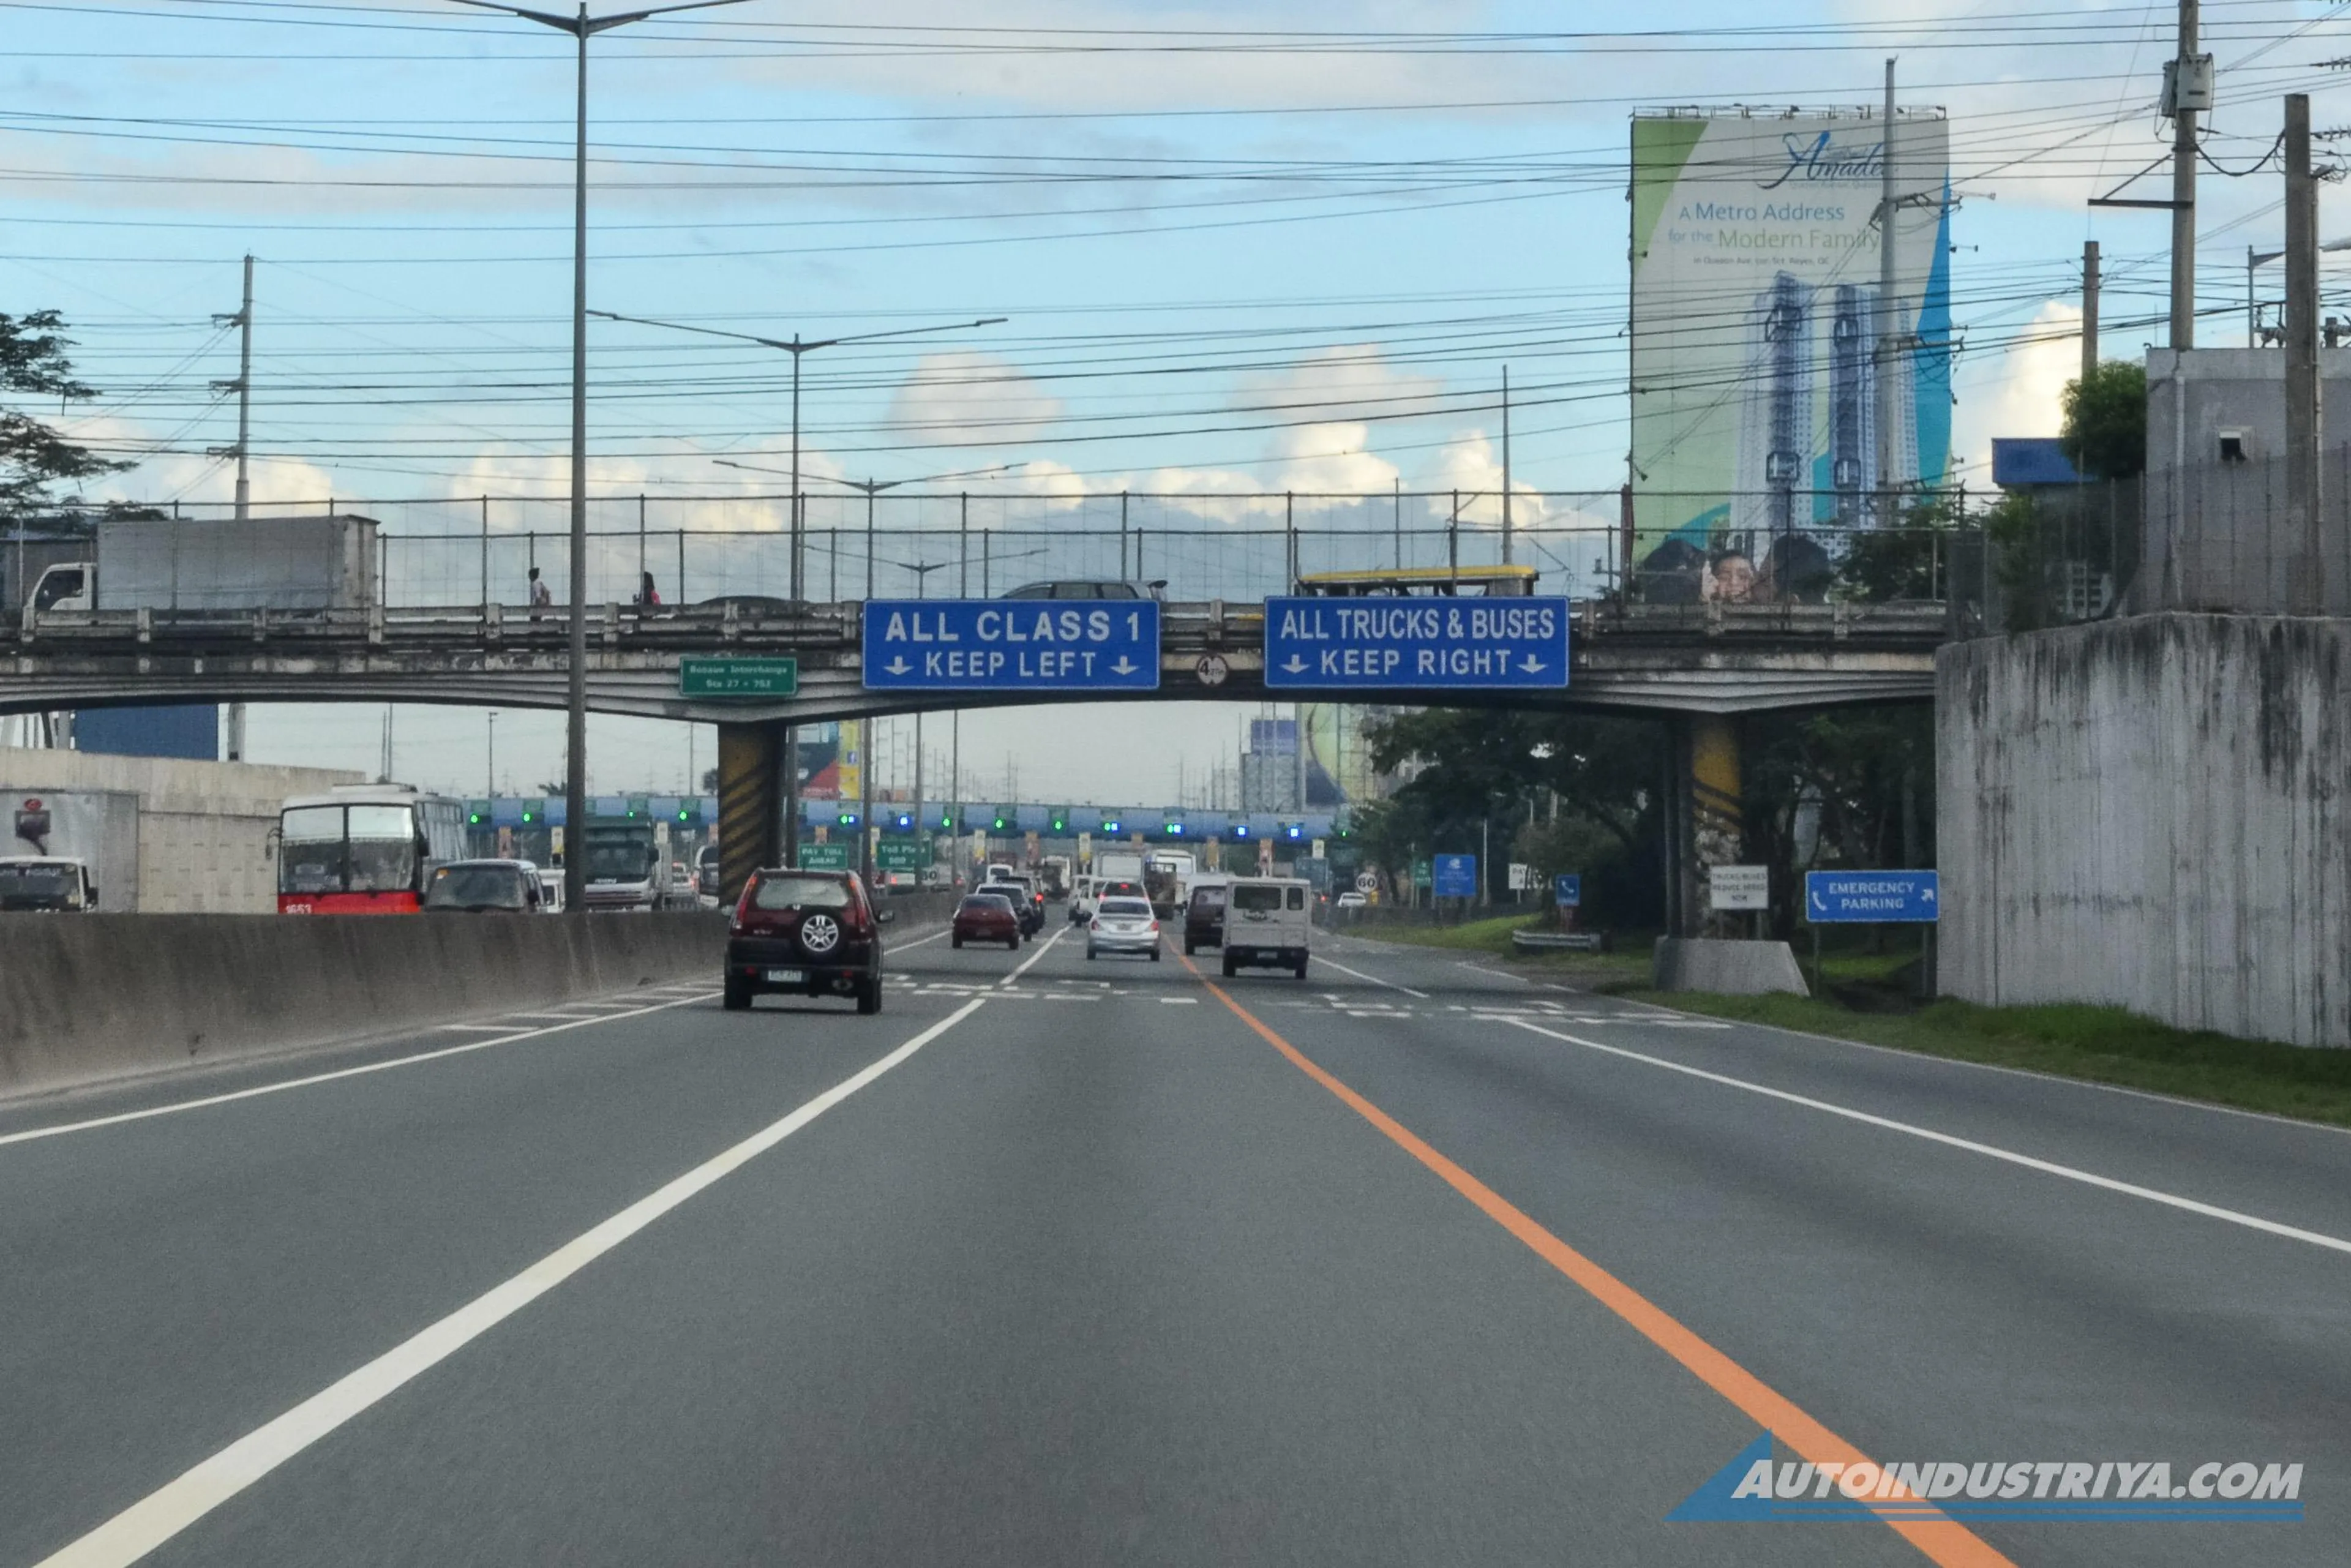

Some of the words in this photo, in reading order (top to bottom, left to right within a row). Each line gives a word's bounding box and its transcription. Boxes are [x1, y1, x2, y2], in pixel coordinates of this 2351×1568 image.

[1757, 130, 1887, 190] Amade
[1679, 206, 1691, 220] A
[1695, 202, 1757, 220] Metro
[1763, 202, 1845, 220] Address
[1668, 228, 1686, 243] for
[1690, 229, 1713, 243] the
[1719, 228, 1803, 249] Modern
[1809, 228, 1880, 253] Family
[885, 612, 959, 642] ALL
[977, 610, 1111, 642] CLASS
[1127, 612, 1139, 642] 1
[1280, 609, 1330, 640] ALL
[1337, 609, 1439, 640] TRUCKS
[1447, 609, 1464, 640] &
[1471, 608, 1555, 639] BUSES
[925, 651, 1005, 677] KEEP
[1019, 651, 1097, 677] LEFT
[1321, 650, 1400, 675] KEEP
[1417, 650, 1512, 675] RIGHT
[1828, 882, 1915, 895] EMERGENCY
[1840, 898, 1904, 910] PARKING
